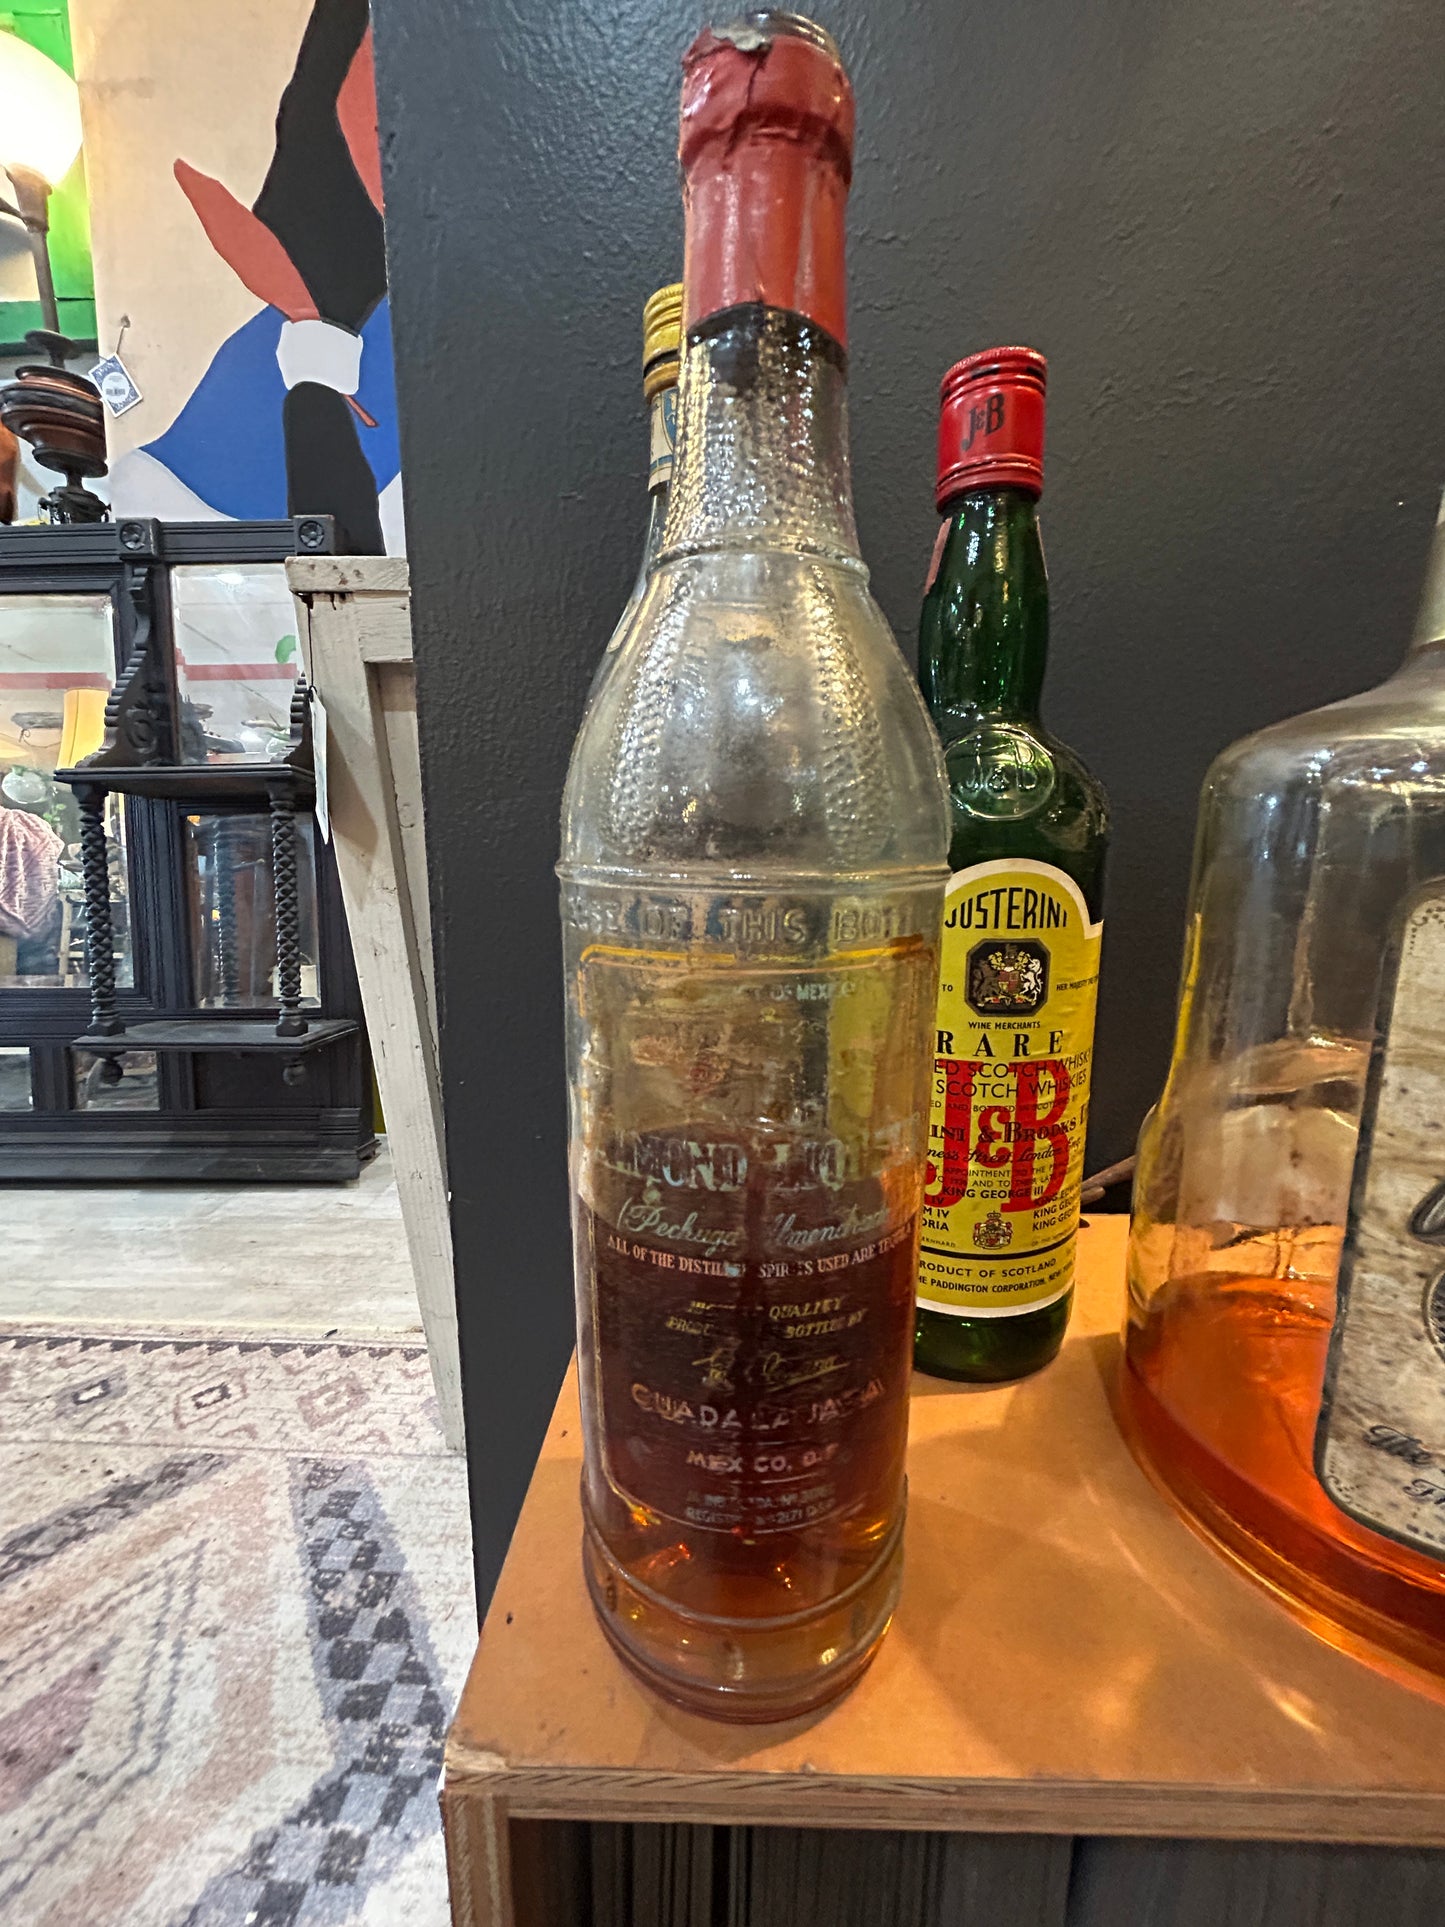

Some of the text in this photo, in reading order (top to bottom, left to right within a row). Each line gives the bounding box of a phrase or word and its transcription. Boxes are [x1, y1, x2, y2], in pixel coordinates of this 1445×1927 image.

[961, 393, 1006, 452] J&B
[944, 887, 1068, 930] JUSTERINI
[721, 906, 807, 943] THIS
[796, 981, 857, 1002] MEXIO
[942, 984, 954, 993] TO
[968, 1021, 1042, 1030] WINE MERCHANTS
[935, 1030, 1064, 1058] RARE
[967, 1061, 1047, 1078] SCOTCH
[936, 1068, 1087, 1098] SCOTCH WHISKIES
[978, 1126, 995, 1143] &
[943, 1186, 1044, 1199] KING GEORGE III
[972, 1180, 993, 1188] AND
[998, 1180, 1011, 1188] TO
[937, 1208, 950, 1219] IV
[1033, 1204, 1057, 1220] KING
[1032, 1216, 1056, 1232] KING
[607, 1234, 631, 1256] ALL
[632, 1244, 649, 1262] OF
[650, 1249, 675, 1268] THE
[758, 1259, 814, 1279] SPIRTS
[817, 1252, 850, 1273] USED
[851, 1244, 876, 1265] ARE
[978, 1269, 996, 1279] OF
[1001, 1257, 1058, 1278] SCOTLAND
[930, 1278, 989, 1293] PADDINGTON
